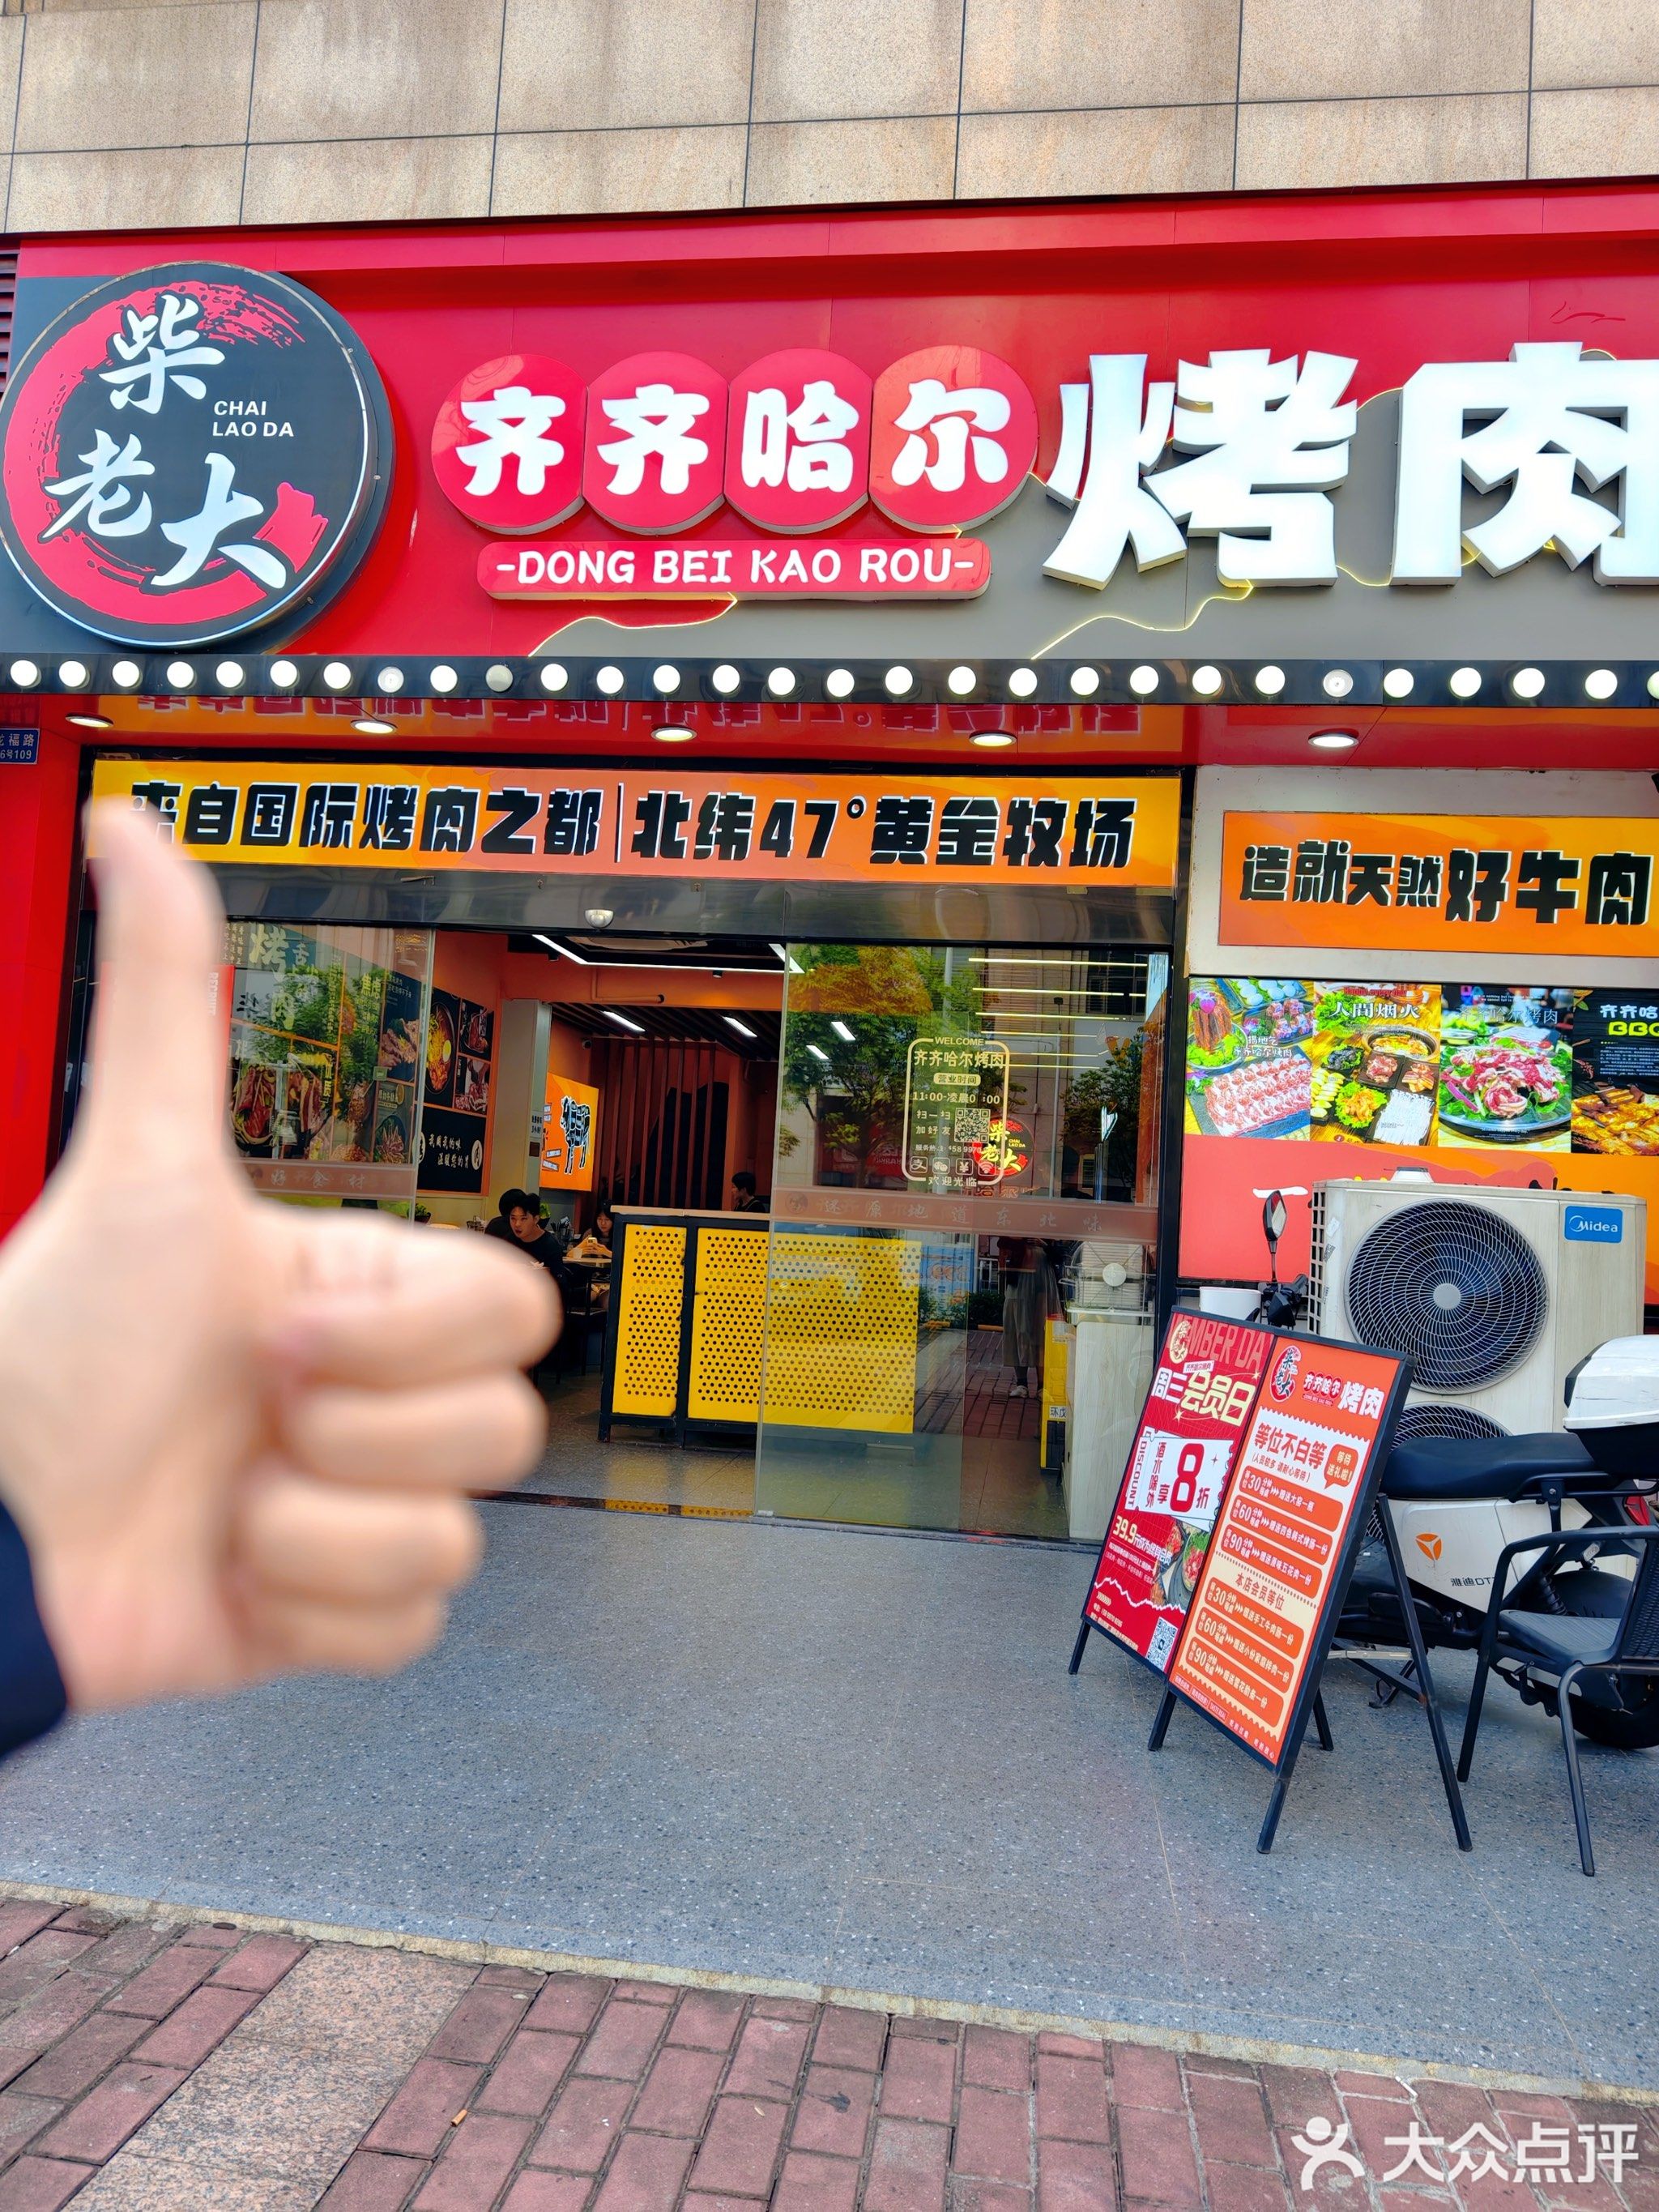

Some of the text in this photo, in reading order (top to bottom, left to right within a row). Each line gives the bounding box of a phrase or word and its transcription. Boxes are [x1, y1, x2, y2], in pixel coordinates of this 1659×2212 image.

[214, 400, 267, 415] CHAI
[212, 421, 294, 437] LAO DA
[455, 341, 1659, 591] 齐齐哈尔 烤肉
[653, 549, 731, 584] BEI
[751, 549, 841, 584] KAO
[0, 749, 32, 759] 6号109
[130, 780, 1138, 869] 来自国际烤肉之都 北纬47°黄金牧场
[1239, 839, 1653, 926] 造就天然好牛肉
[1329, 1002, 1420, 1019] 人間烟火
[1600, 1004, 1658, 1019] 齐齐哈
[935, 1036, 984, 1046] WELCOME
[914, 1050, 1004, 1069] 齐齐哈尔烤肉
[938, 1074, 977, 1084] 营业时间
[916, 1109, 951, 1120] 扫一扫
[915, 1125, 951, 1135] 加好友
[928, 1176, 977, 1188] 欢迎光临
[1570, 1215, 1618, 1234] Midea
[1166, 1312, 1273, 1373] MMBER DA
[1151, 1367, 1256, 1426] 周三会员日
[1303, 1374, 1385, 1418] 齐齐哈尔 烤肉
[1252, 1423, 1327, 1470] 等位不白等
[1336, 1450, 1352, 1466] 等待
[1128, 1441, 1147, 1505] DISCOUNT
[1247, 1474, 1262, 1492] 30
[1238, 1503, 1252, 1522] 60
[1228, 1533, 1243, 1552] 90
[1235, 1572, 1284, 1610] 本店会员等位
[1451, 1577, 1495, 1586] 雅迪DT
[1212, 1586, 1226, 1606] 30
[1203, 1616, 1217, 1637] 60
[1193, 1646, 1207, 1668] 90
